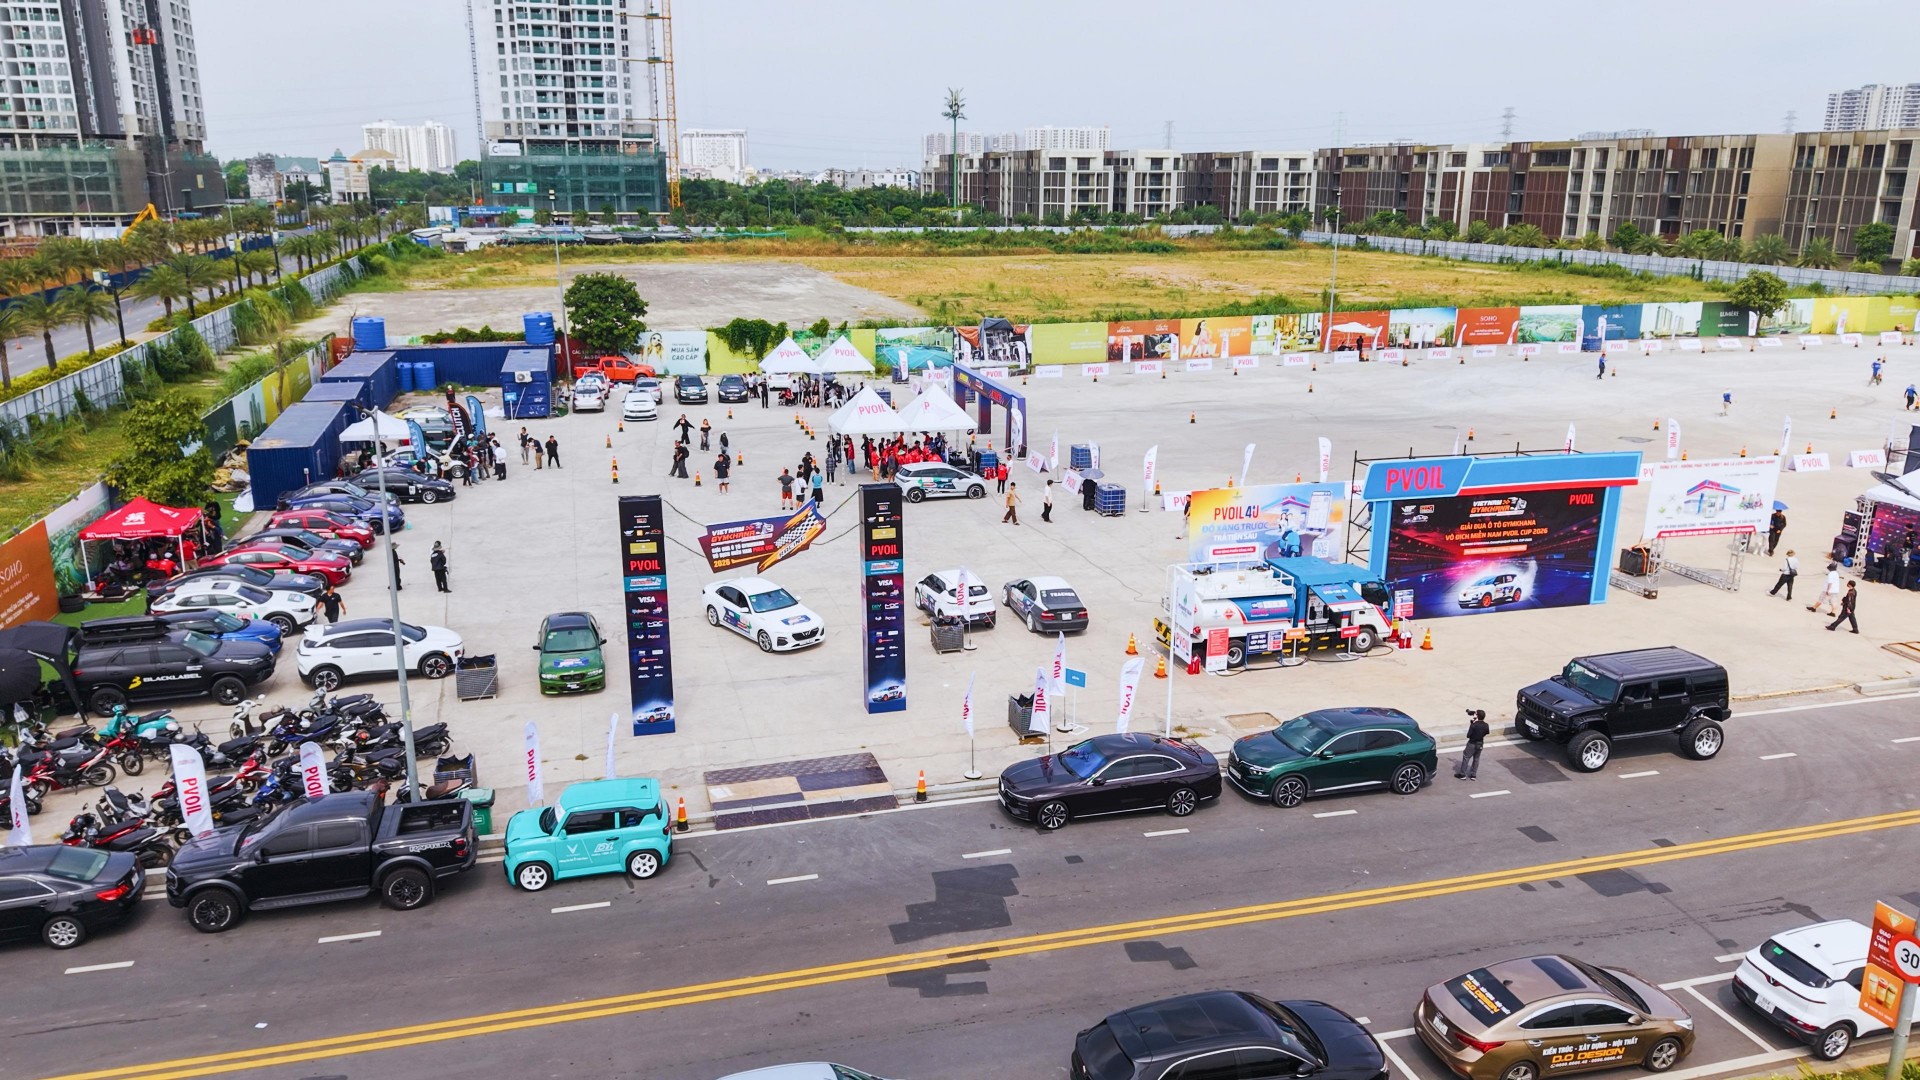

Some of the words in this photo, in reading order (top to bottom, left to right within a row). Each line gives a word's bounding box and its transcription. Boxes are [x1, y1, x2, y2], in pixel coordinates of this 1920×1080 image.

[835, 349, 856, 357] PVOIL
[859, 404, 886, 415] PVOIL
[1802, 458, 1824, 468] PVOIL
[1859, 455, 1880, 463] PVOIL
[1386, 466, 1446, 492] PVOIL
[1569, 494, 1594, 505] PVOIL
[1214, 506, 1244, 520] PVOIL
[1471, 505, 1510, 513] GYMKHANA
[711, 531, 755, 542] GYMKHANA
[712, 526, 744, 536] VIETNAM
[872, 545, 898, 556] PVOIL
[630, 560, 660, 571] PVOIL
[714, 559, 730, 568] 2026
[143, 673, 202, 682] BLACKLABEL
[182, 777, 202, 817] PVOIL
[1901, 948, 1920, 969] 30
[1543, 1046, 1557, 1056] KIẾN
[1558, 1045, 1573, 1054] TRÚC
[1579, 1043, 1590, 1051] XÂY
[1578, 1047, 1625, 1060] DESIGN
